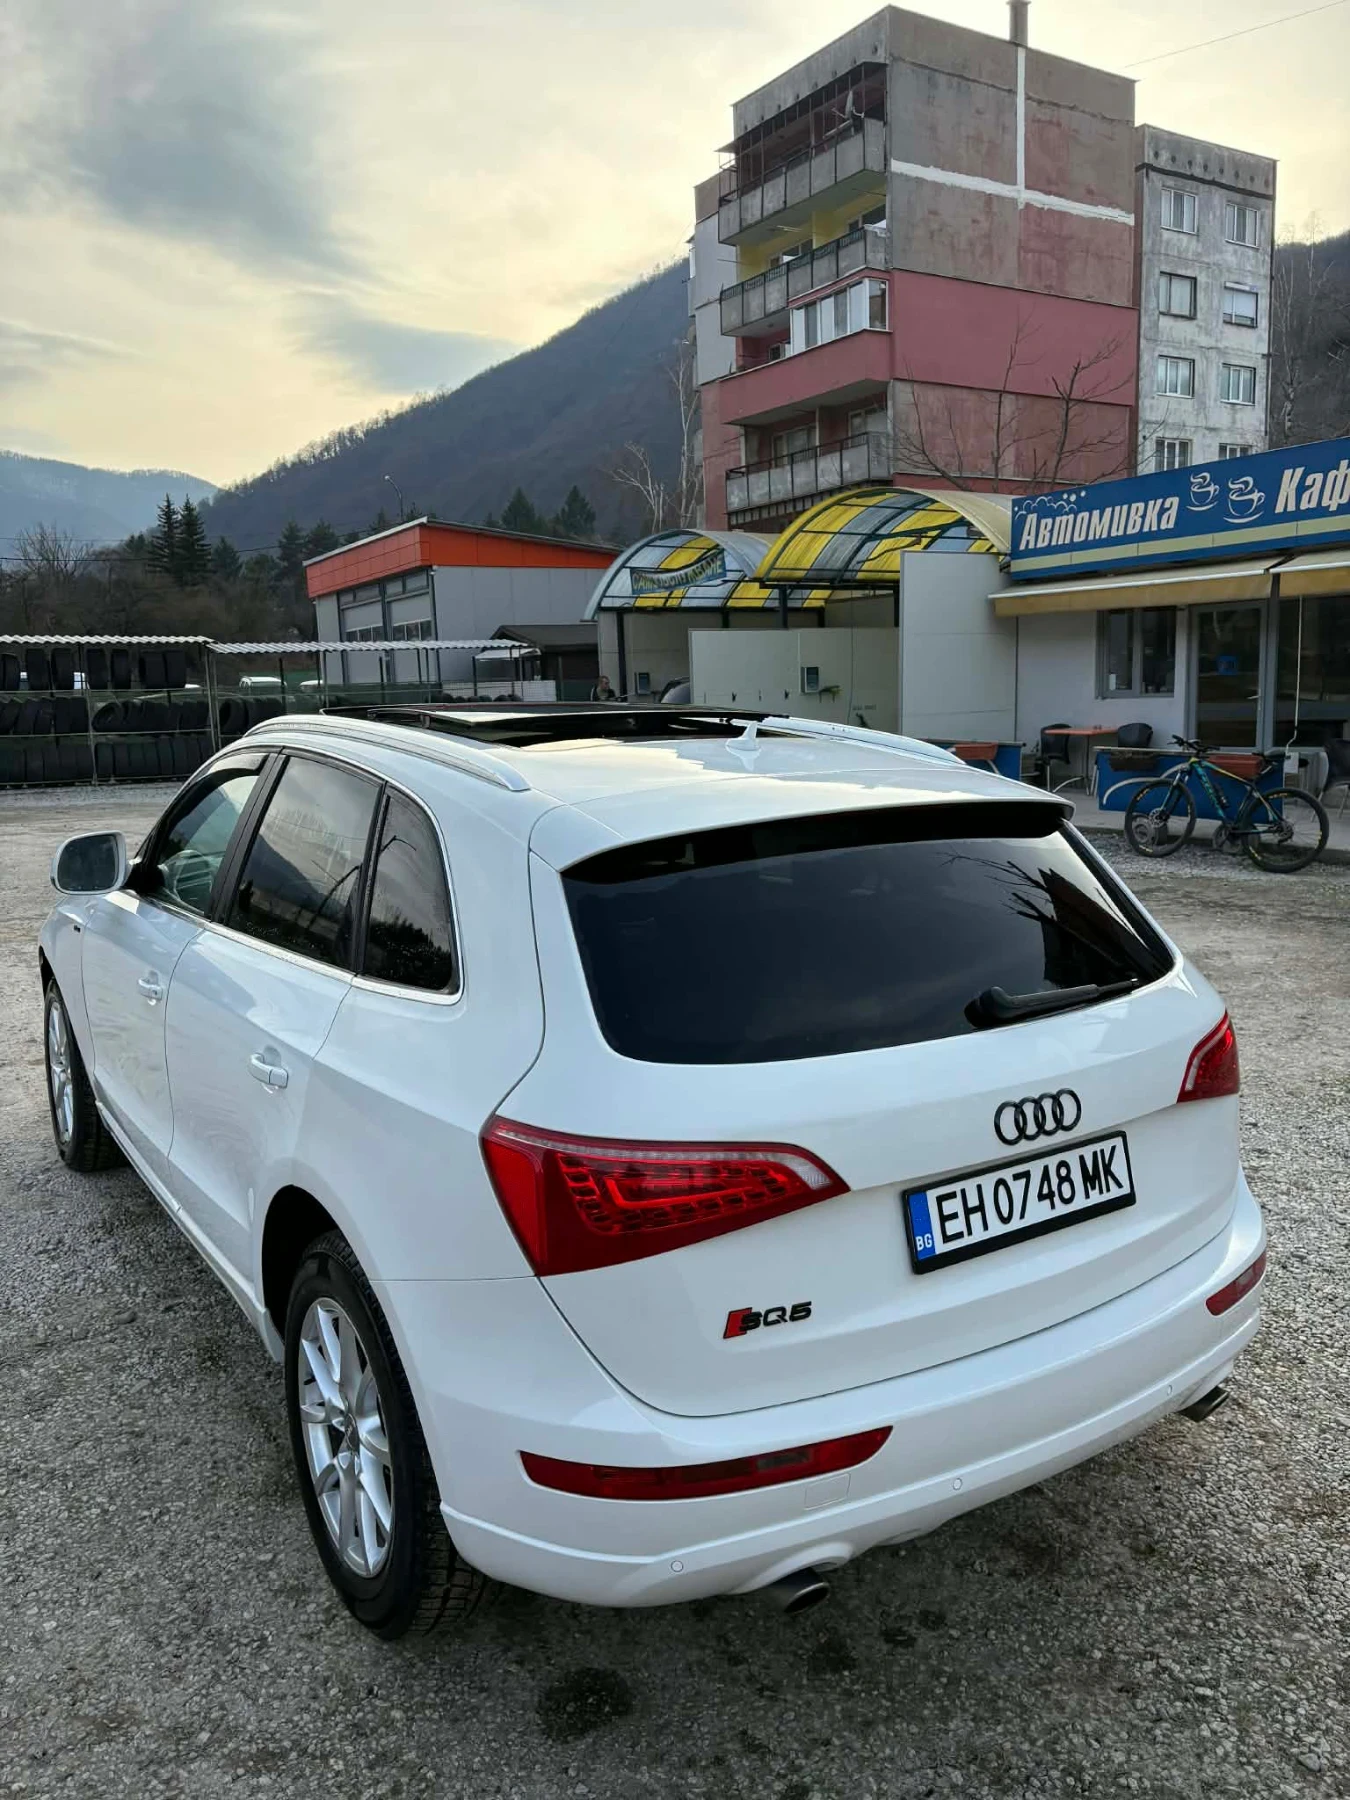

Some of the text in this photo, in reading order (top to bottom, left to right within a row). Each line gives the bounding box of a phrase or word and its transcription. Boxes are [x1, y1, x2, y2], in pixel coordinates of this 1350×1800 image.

[1019, 497, 1179, 550] Автомивка
[915, 1233, 933, 1251] BG
[739, 1301, 812, 1332] SQ5
